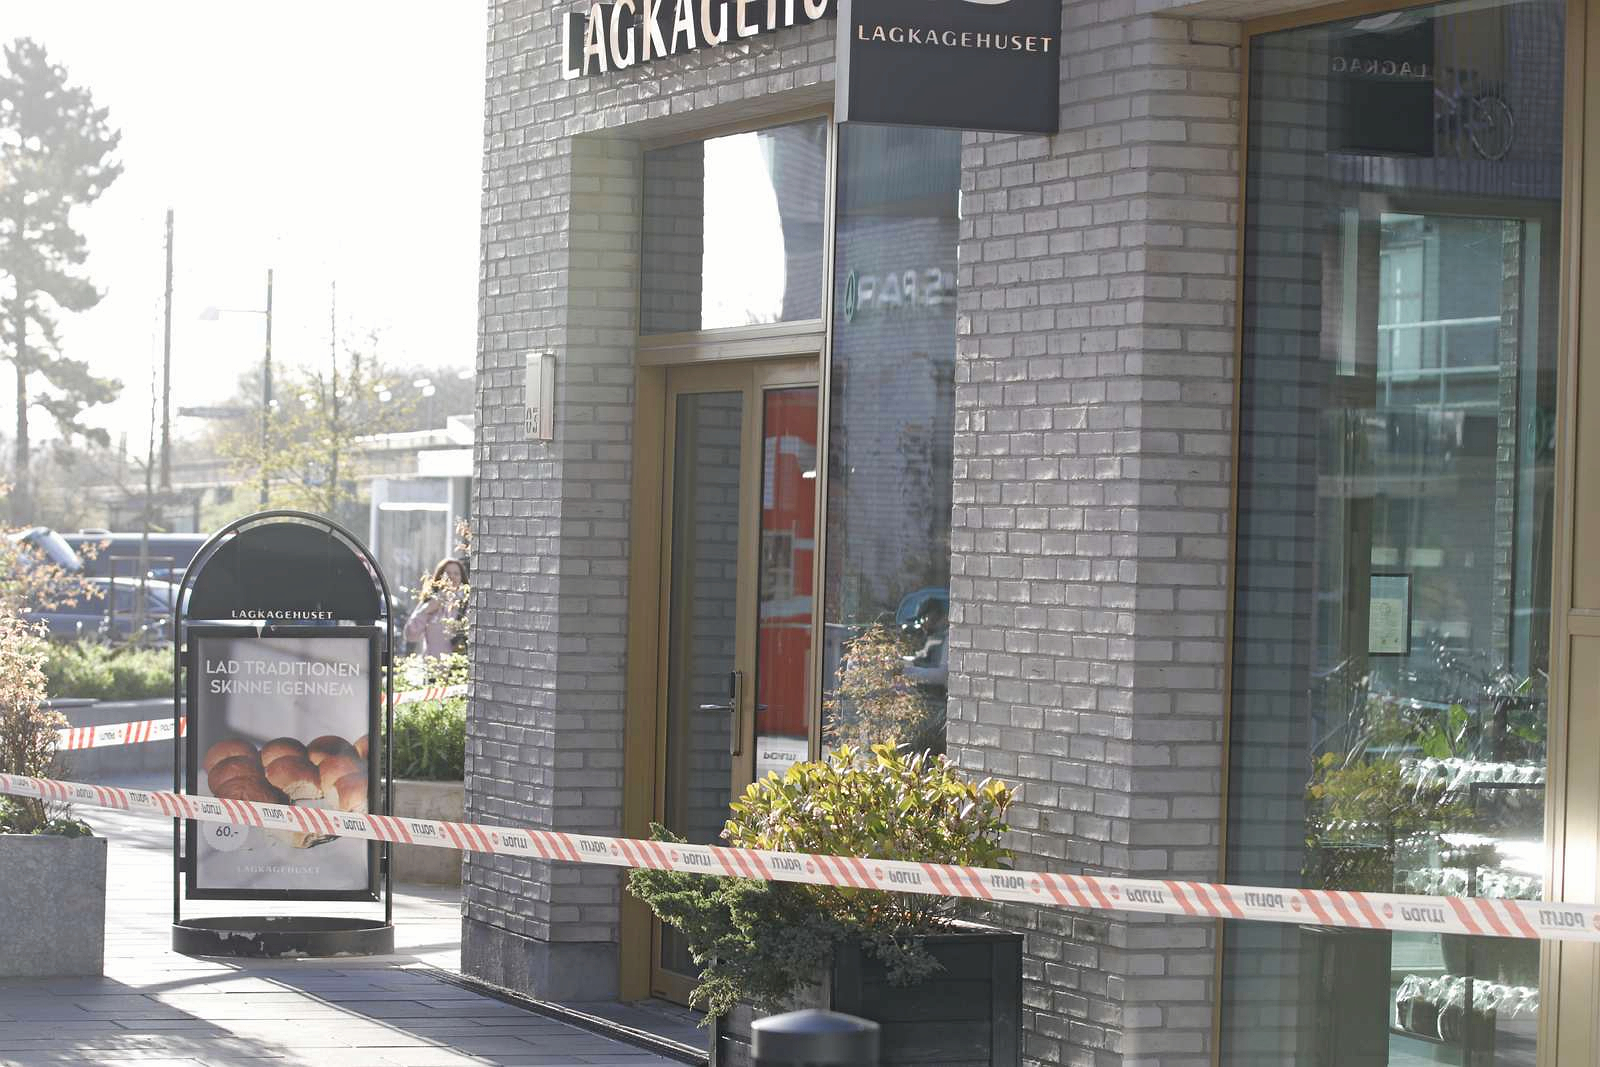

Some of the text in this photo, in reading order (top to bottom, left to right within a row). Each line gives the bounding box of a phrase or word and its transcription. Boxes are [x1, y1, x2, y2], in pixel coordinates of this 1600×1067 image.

[562, 0, 829, 80] LAGKAG
[858, 24, 1052, 53] LAGKAGEHUSET
[231, 609, 334, 620] LAGKAGEHUSET
[206, 660, 360, 677] LAD TRADITIONEN
[210, 679, 354, 696] SKINNE IGENNEM
[215, 825, 239, 838] 60.-
